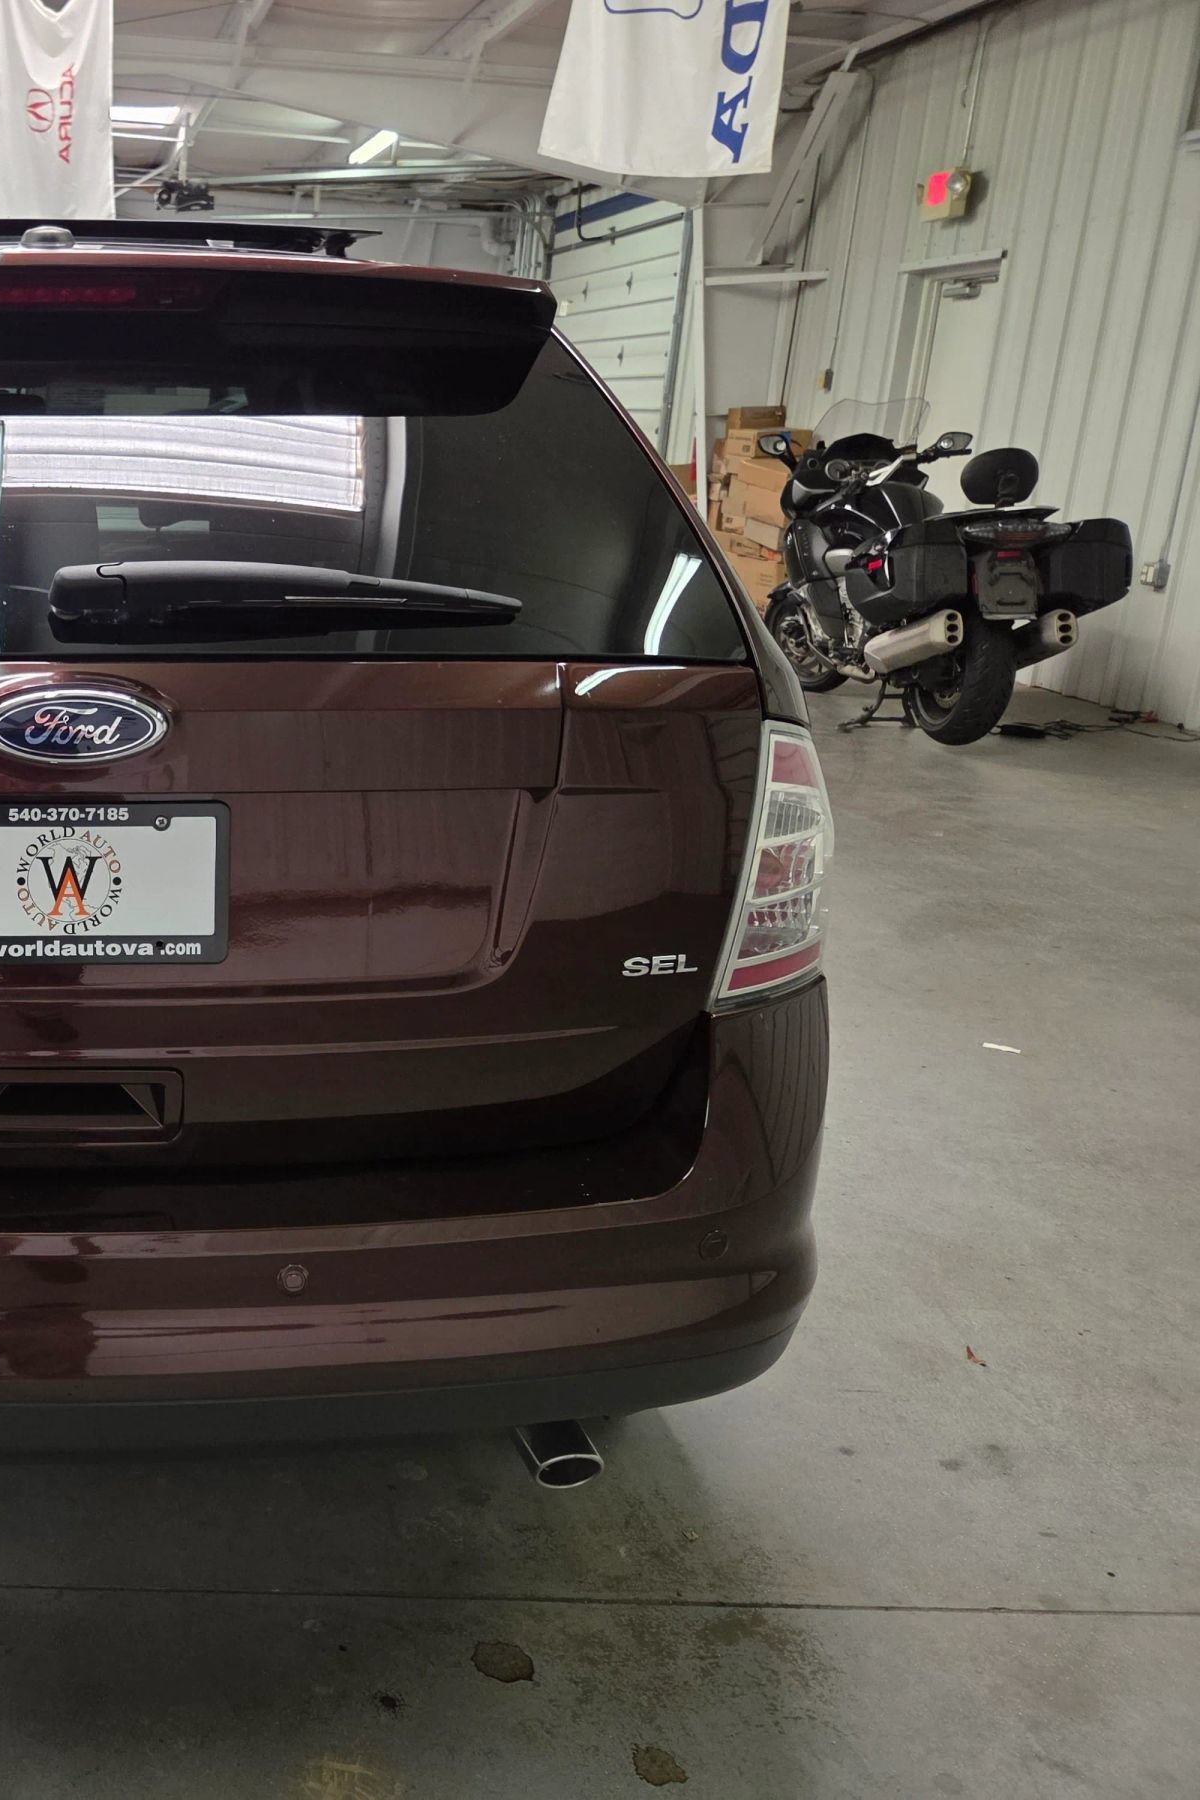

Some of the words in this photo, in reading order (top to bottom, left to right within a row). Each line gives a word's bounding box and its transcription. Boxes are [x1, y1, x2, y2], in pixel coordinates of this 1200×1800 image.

[24, 706, 123, 745] Ford
[8, 807, 130, 822] 540-370-7185
[16, 826, 76, 874] WORLD
[79, 829, 122, 874] AUTO
[16, 887, 60, 931] AUTO
[63, 887, 122, 935] WORLD
[621, 954, 699, 977] SEL
